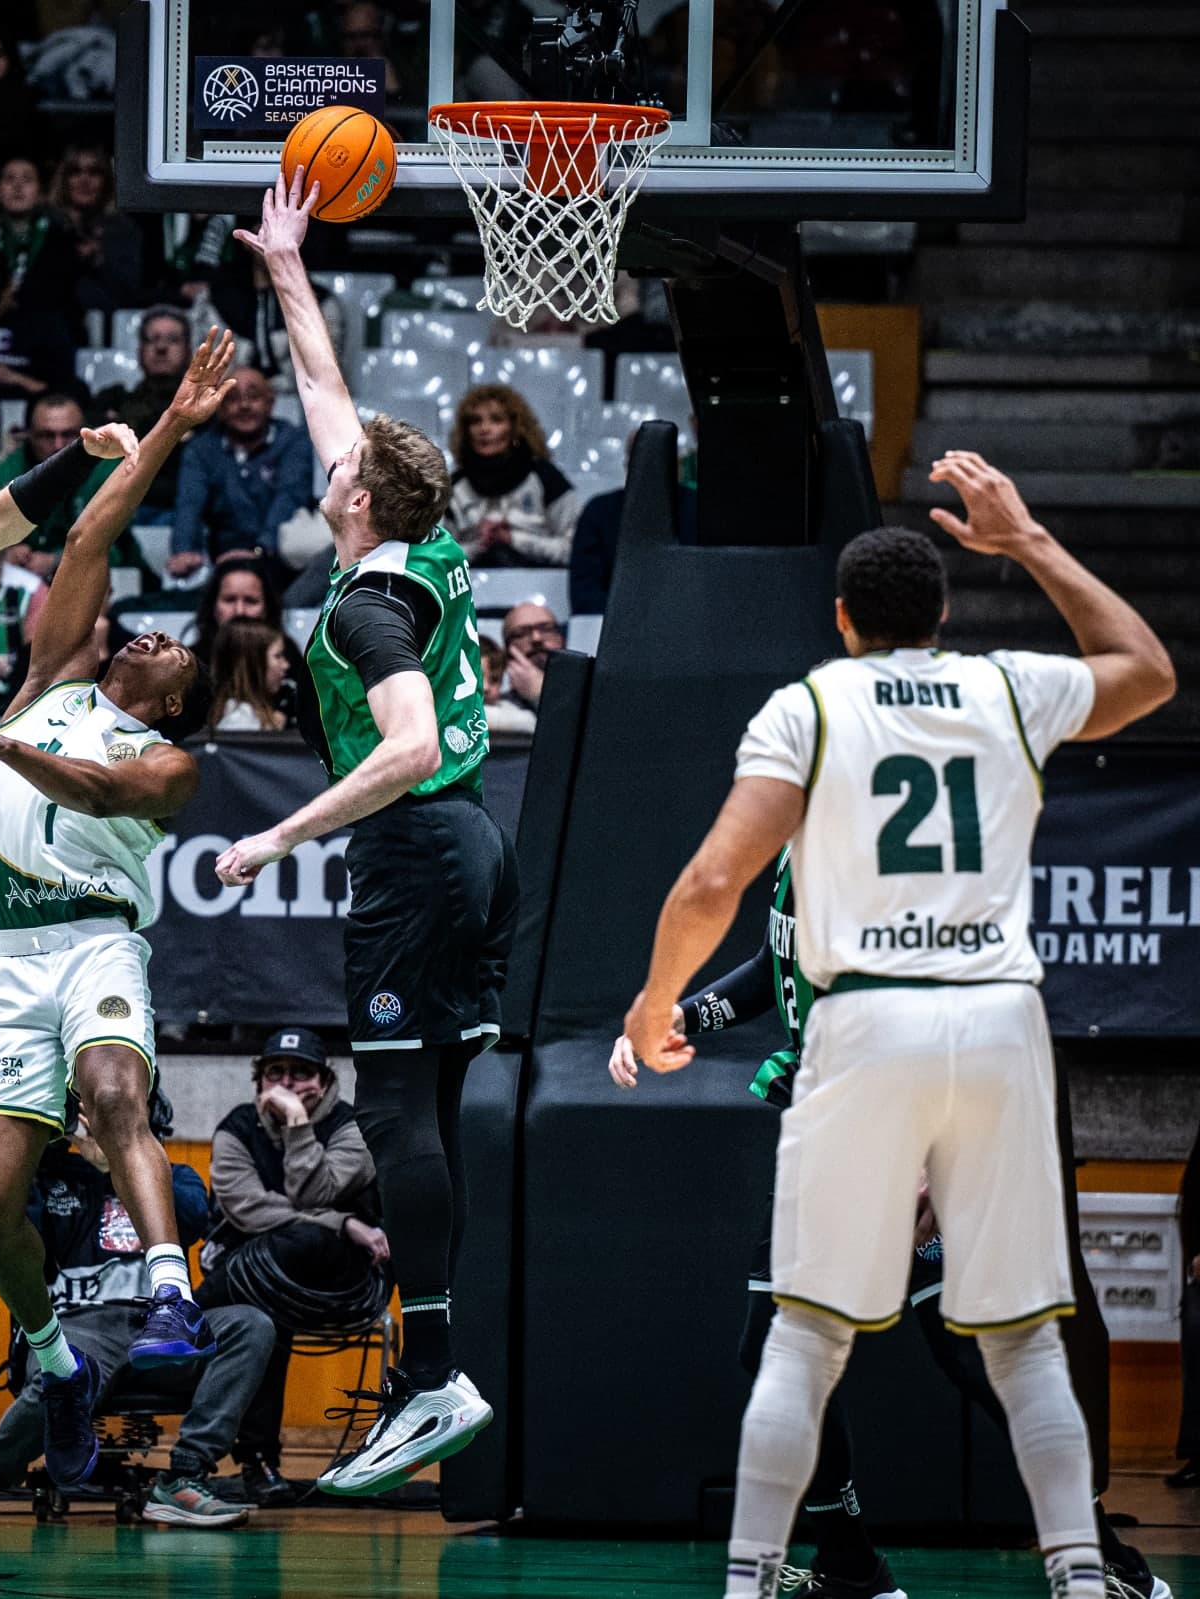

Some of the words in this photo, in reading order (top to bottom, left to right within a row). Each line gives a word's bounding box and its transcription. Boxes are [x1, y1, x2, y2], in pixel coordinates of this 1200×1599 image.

[265, 64, 365, 77] BASKETBALL
[265, 79, 377, 93] CHAMPIONS
[265, 95, 325, 107] LEAGUE
[871, 753, 982, 875] 21
[1035, 932, 1161, 965] DAMM
[703, 991, 724, 1031] NOCCO
[3, 1068, 23, 1077] SOL
